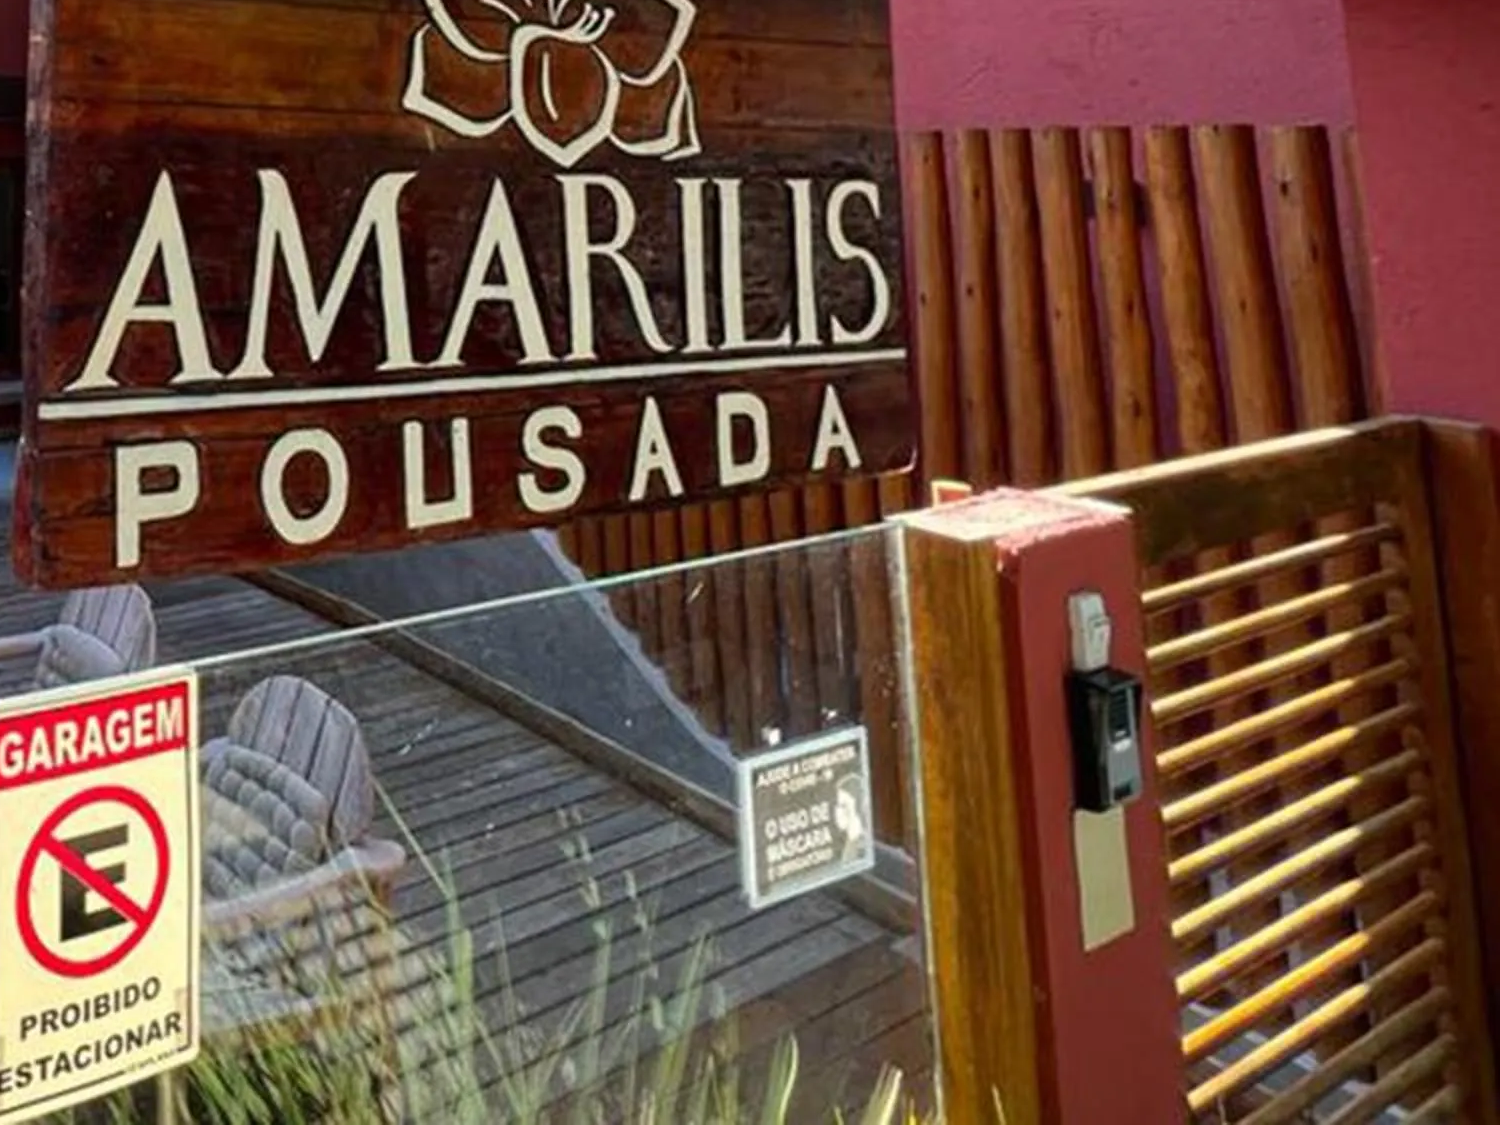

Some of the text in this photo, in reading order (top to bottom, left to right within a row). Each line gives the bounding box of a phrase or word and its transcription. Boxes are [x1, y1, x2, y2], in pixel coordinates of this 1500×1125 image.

[63, 169, 891, 393] AMARILIS
[115, 384, 862, 569] POUSADA
[765, 817, 778, 840] O
[779, 808, 809, 836] USO
[20, 975, 162, 1042] PROIBIDO
